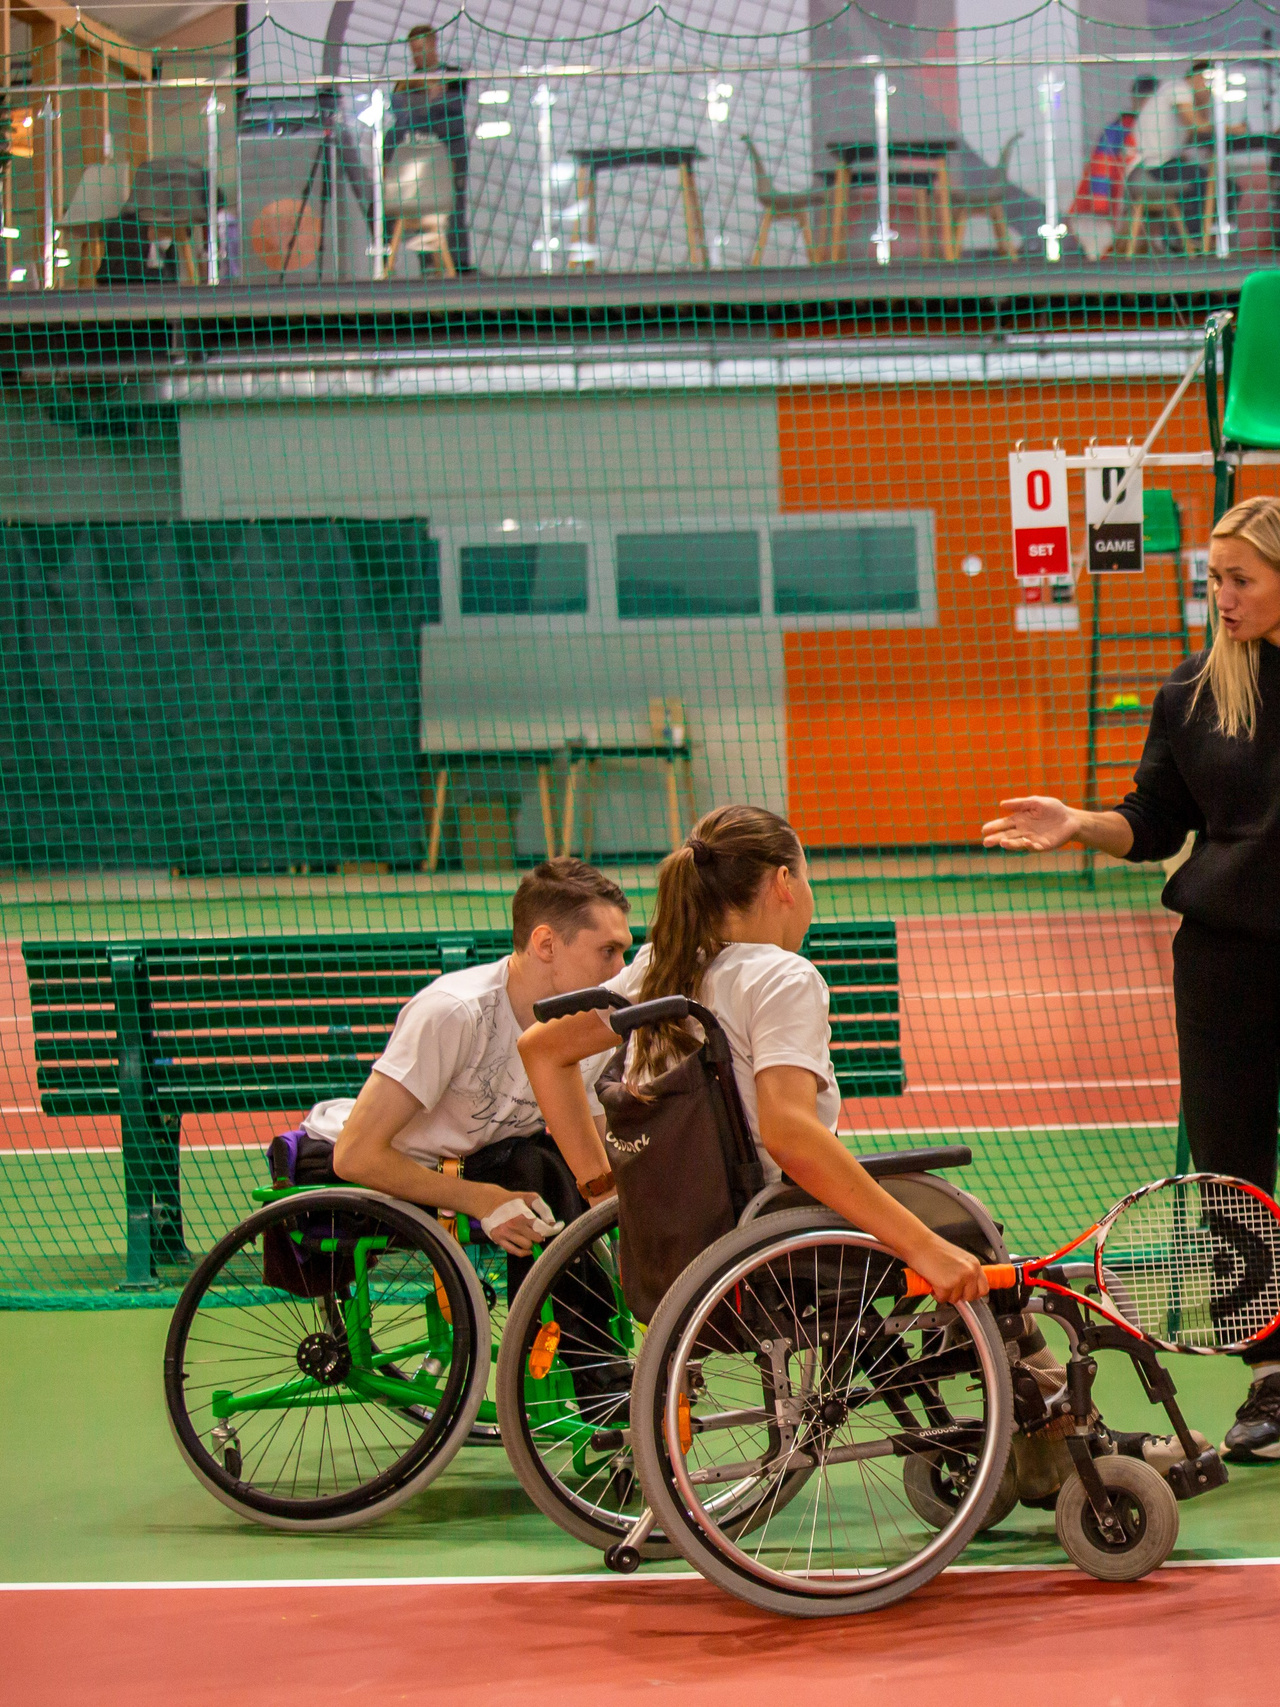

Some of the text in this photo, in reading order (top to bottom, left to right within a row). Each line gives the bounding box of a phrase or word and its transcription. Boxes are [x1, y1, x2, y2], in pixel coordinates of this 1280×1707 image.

[1027, 470, 1051, 511] 0
[1028, 543, 1055, 557] SET
[1095, 540, 1136, 553] GAME
